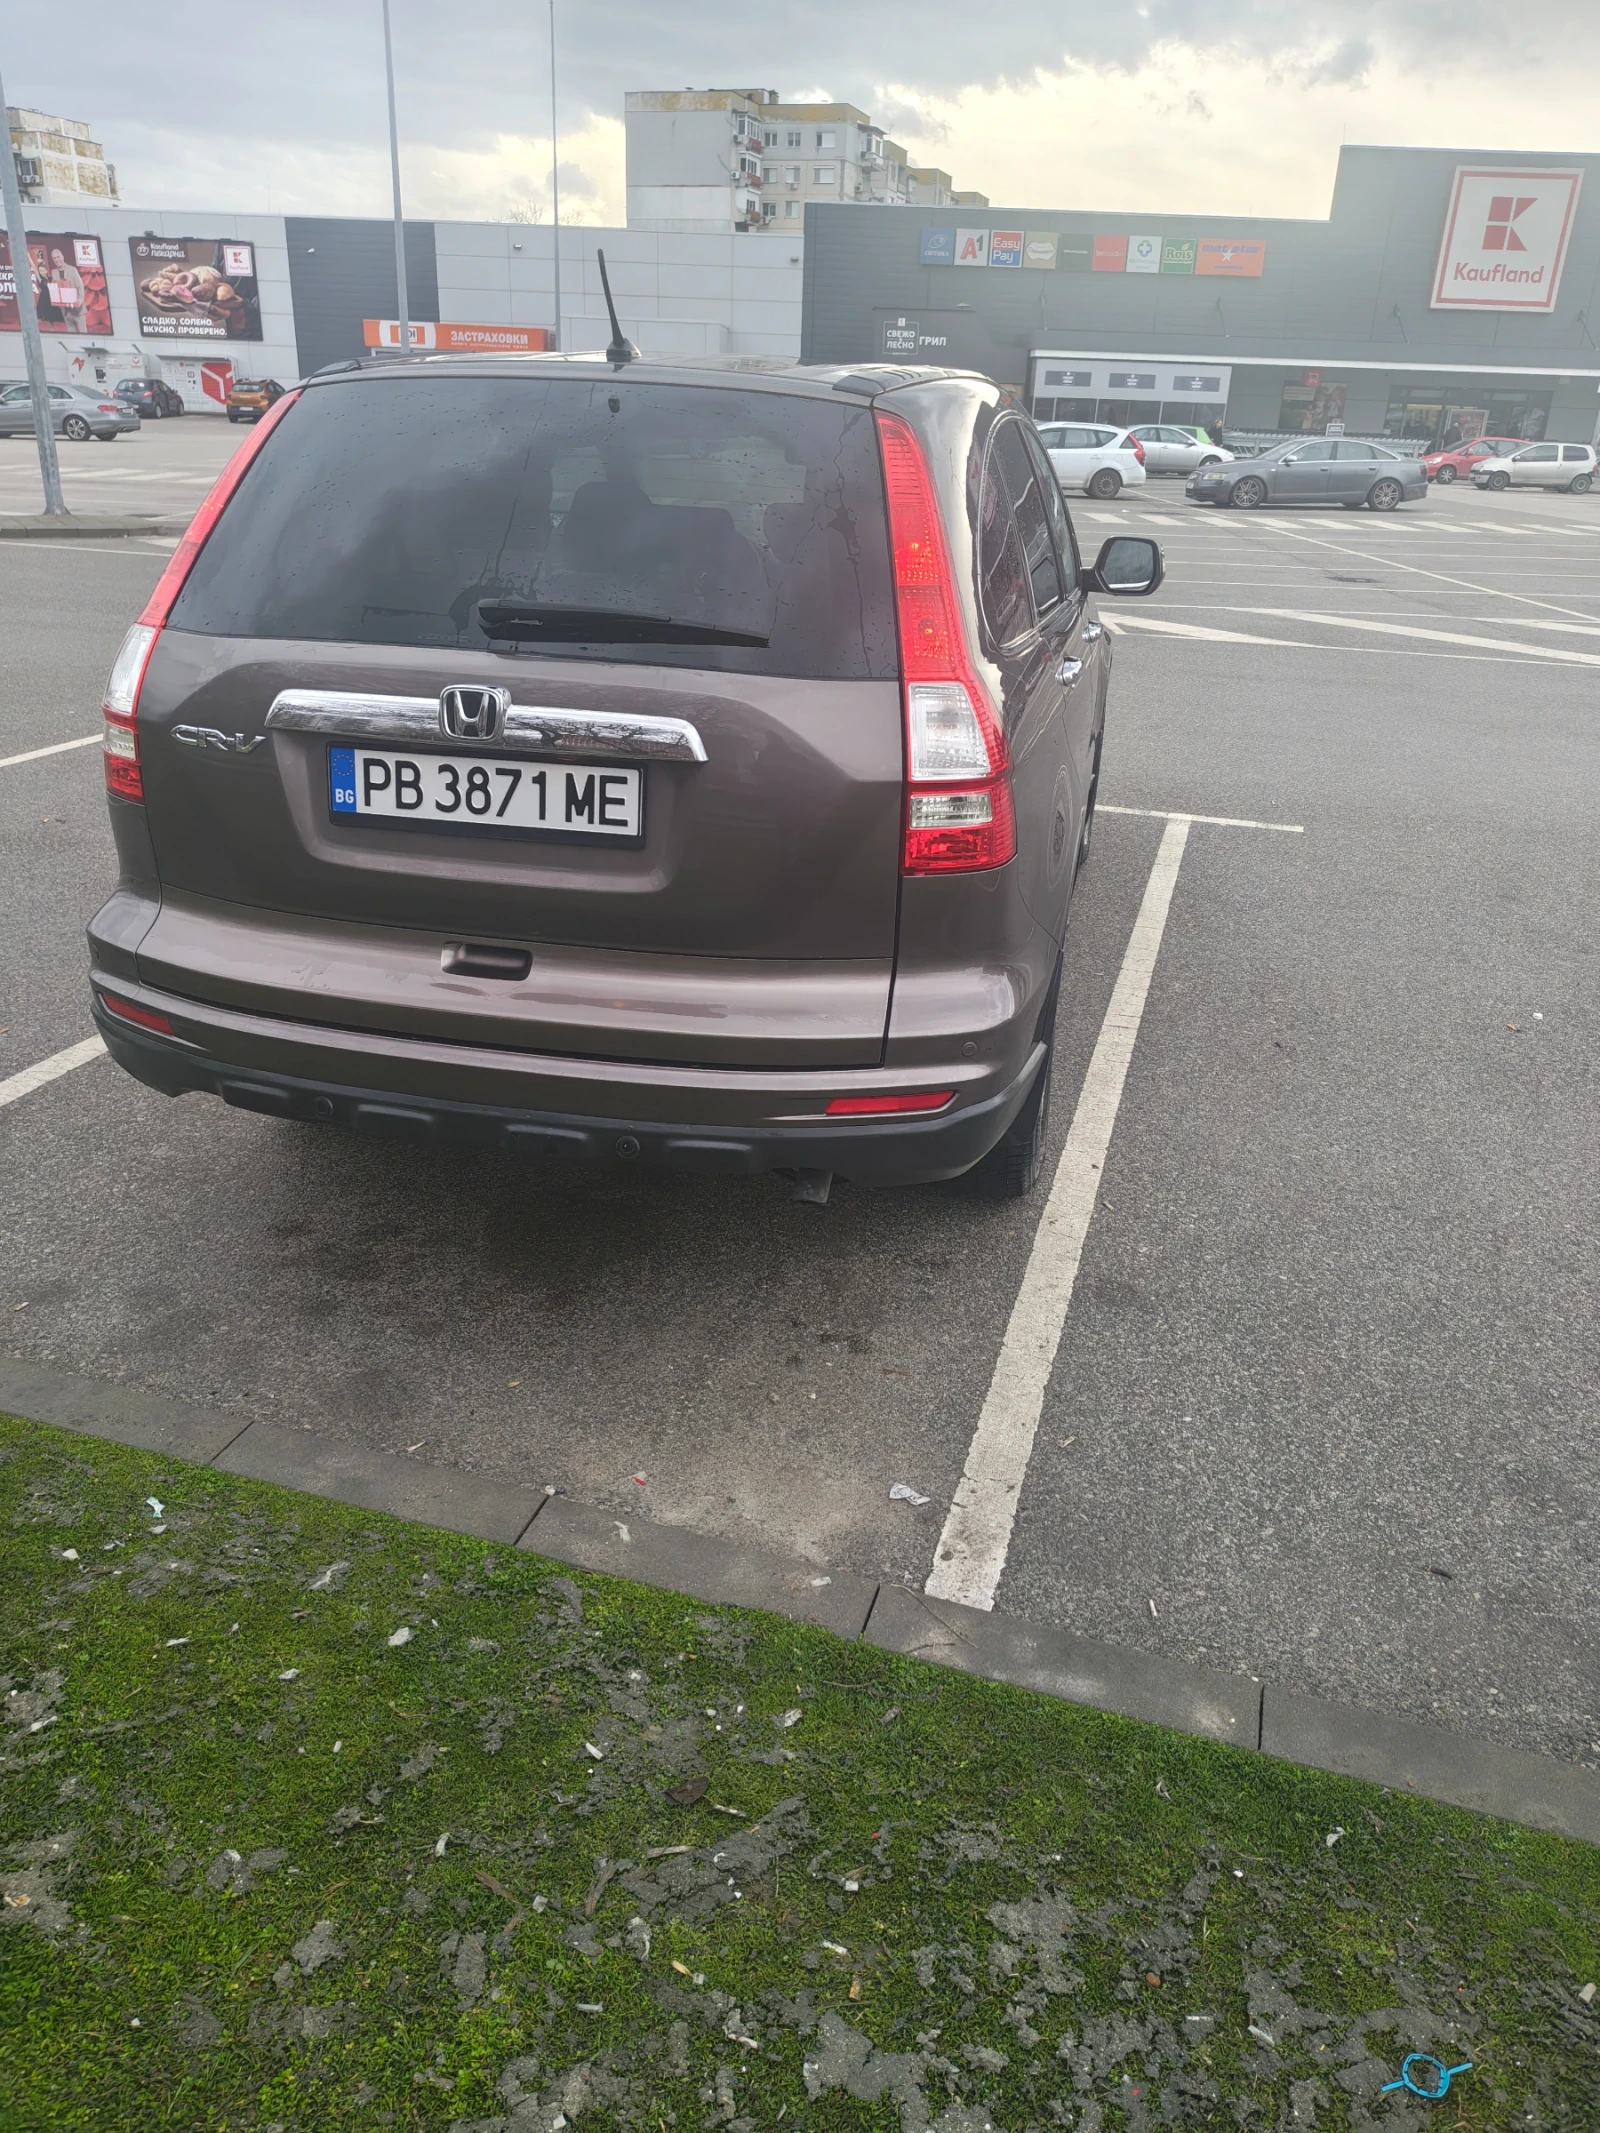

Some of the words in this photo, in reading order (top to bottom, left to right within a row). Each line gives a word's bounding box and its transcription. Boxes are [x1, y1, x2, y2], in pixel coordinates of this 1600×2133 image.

[960, 235, 984, 260] A1
[994, 238, 1020, 251] Easy
[993, 251, 1014, 263] Pay
[1165, 248, 1192, 260] Rois
[1453, 262, 1545, 283] Kaufland
[142, 317, 178, 325] СЛАДКО.
[180, 318, 214, 326] СОЛЕНО.
[143, 326, 177, 334] ВКУСНО.
[178, 327, 227, 336] ПРОВЕРЕНО.
[887, 330, 915, 338] СВЕЖО
[450, 331, 528, 344] ЗАСТРАХОВКИ
[919, 336, 947, 346] ГРИЛ
[887, 341, 914, 349] ЛЕСНО
[170, 724, 267, 754] CR-V
[335, 788, 355, 804] BG
[363, 757, 424, 810] PB
[435, 763, 547, 821] 3871
[565, 772, 629, 827] ME
